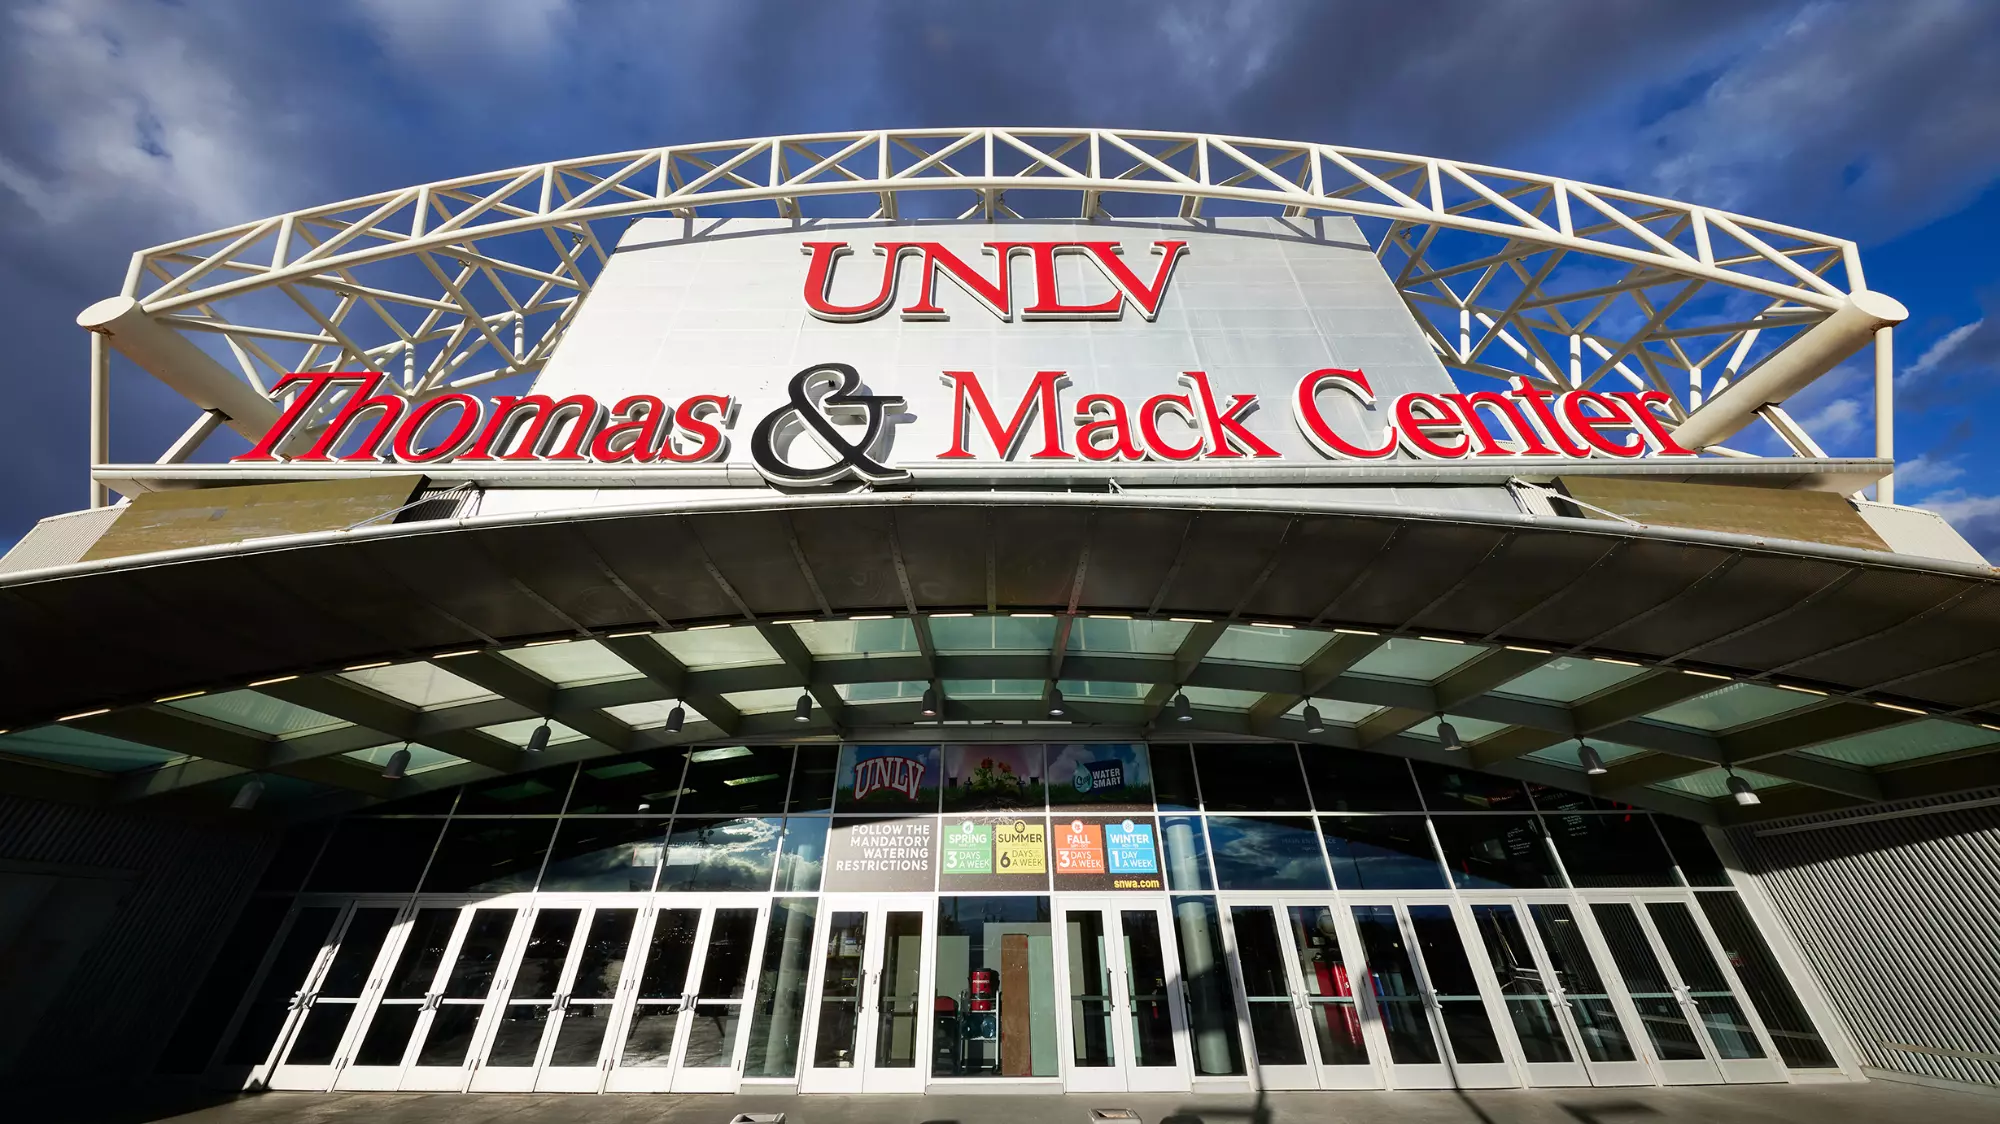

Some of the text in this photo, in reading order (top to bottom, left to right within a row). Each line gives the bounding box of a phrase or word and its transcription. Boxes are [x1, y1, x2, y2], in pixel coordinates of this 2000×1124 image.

[800, 241, 1190, 321] UNLV
[231, 362, 1699, 488] Thomas & Mack Center
[855, 756, 925, 800] UNLV
[1093, 768, 1120, 780] WATER
[1093, 776, 1121, 789] SMART
[851, 824, 930, 836] FOLLOW THE
[850, 836, 930, 847] MANDATORY
[949, 833, 987, 844] SPRING
[998, 833, 1042, 843] SUMMER
[1066, 834, 1091, 844] FALL
[1110, 833, 1150, 844] WINTER
[863, 847, 929, 859] WATERING
[1000, 851, 1011, 868] 6
[1012, 850, 1033, 858] DAYS
[836, 859, 929, 871] RESTRICTIONS
[946, 851, 980, 868] 3 DAYS
[959, 859, 990, 868] A WEEK
[1012, 859, 1043, 867] A WEEK
[1059, 851, 1092, 868] 3 DAYS
[1071, 860, 1102, 868] A WEEK
[1112, 851, 1138, 868] 1 DAY
[1123, 860, 1153, 868] A WEEK
[1113, 879, 1160, 888] snwa.com
